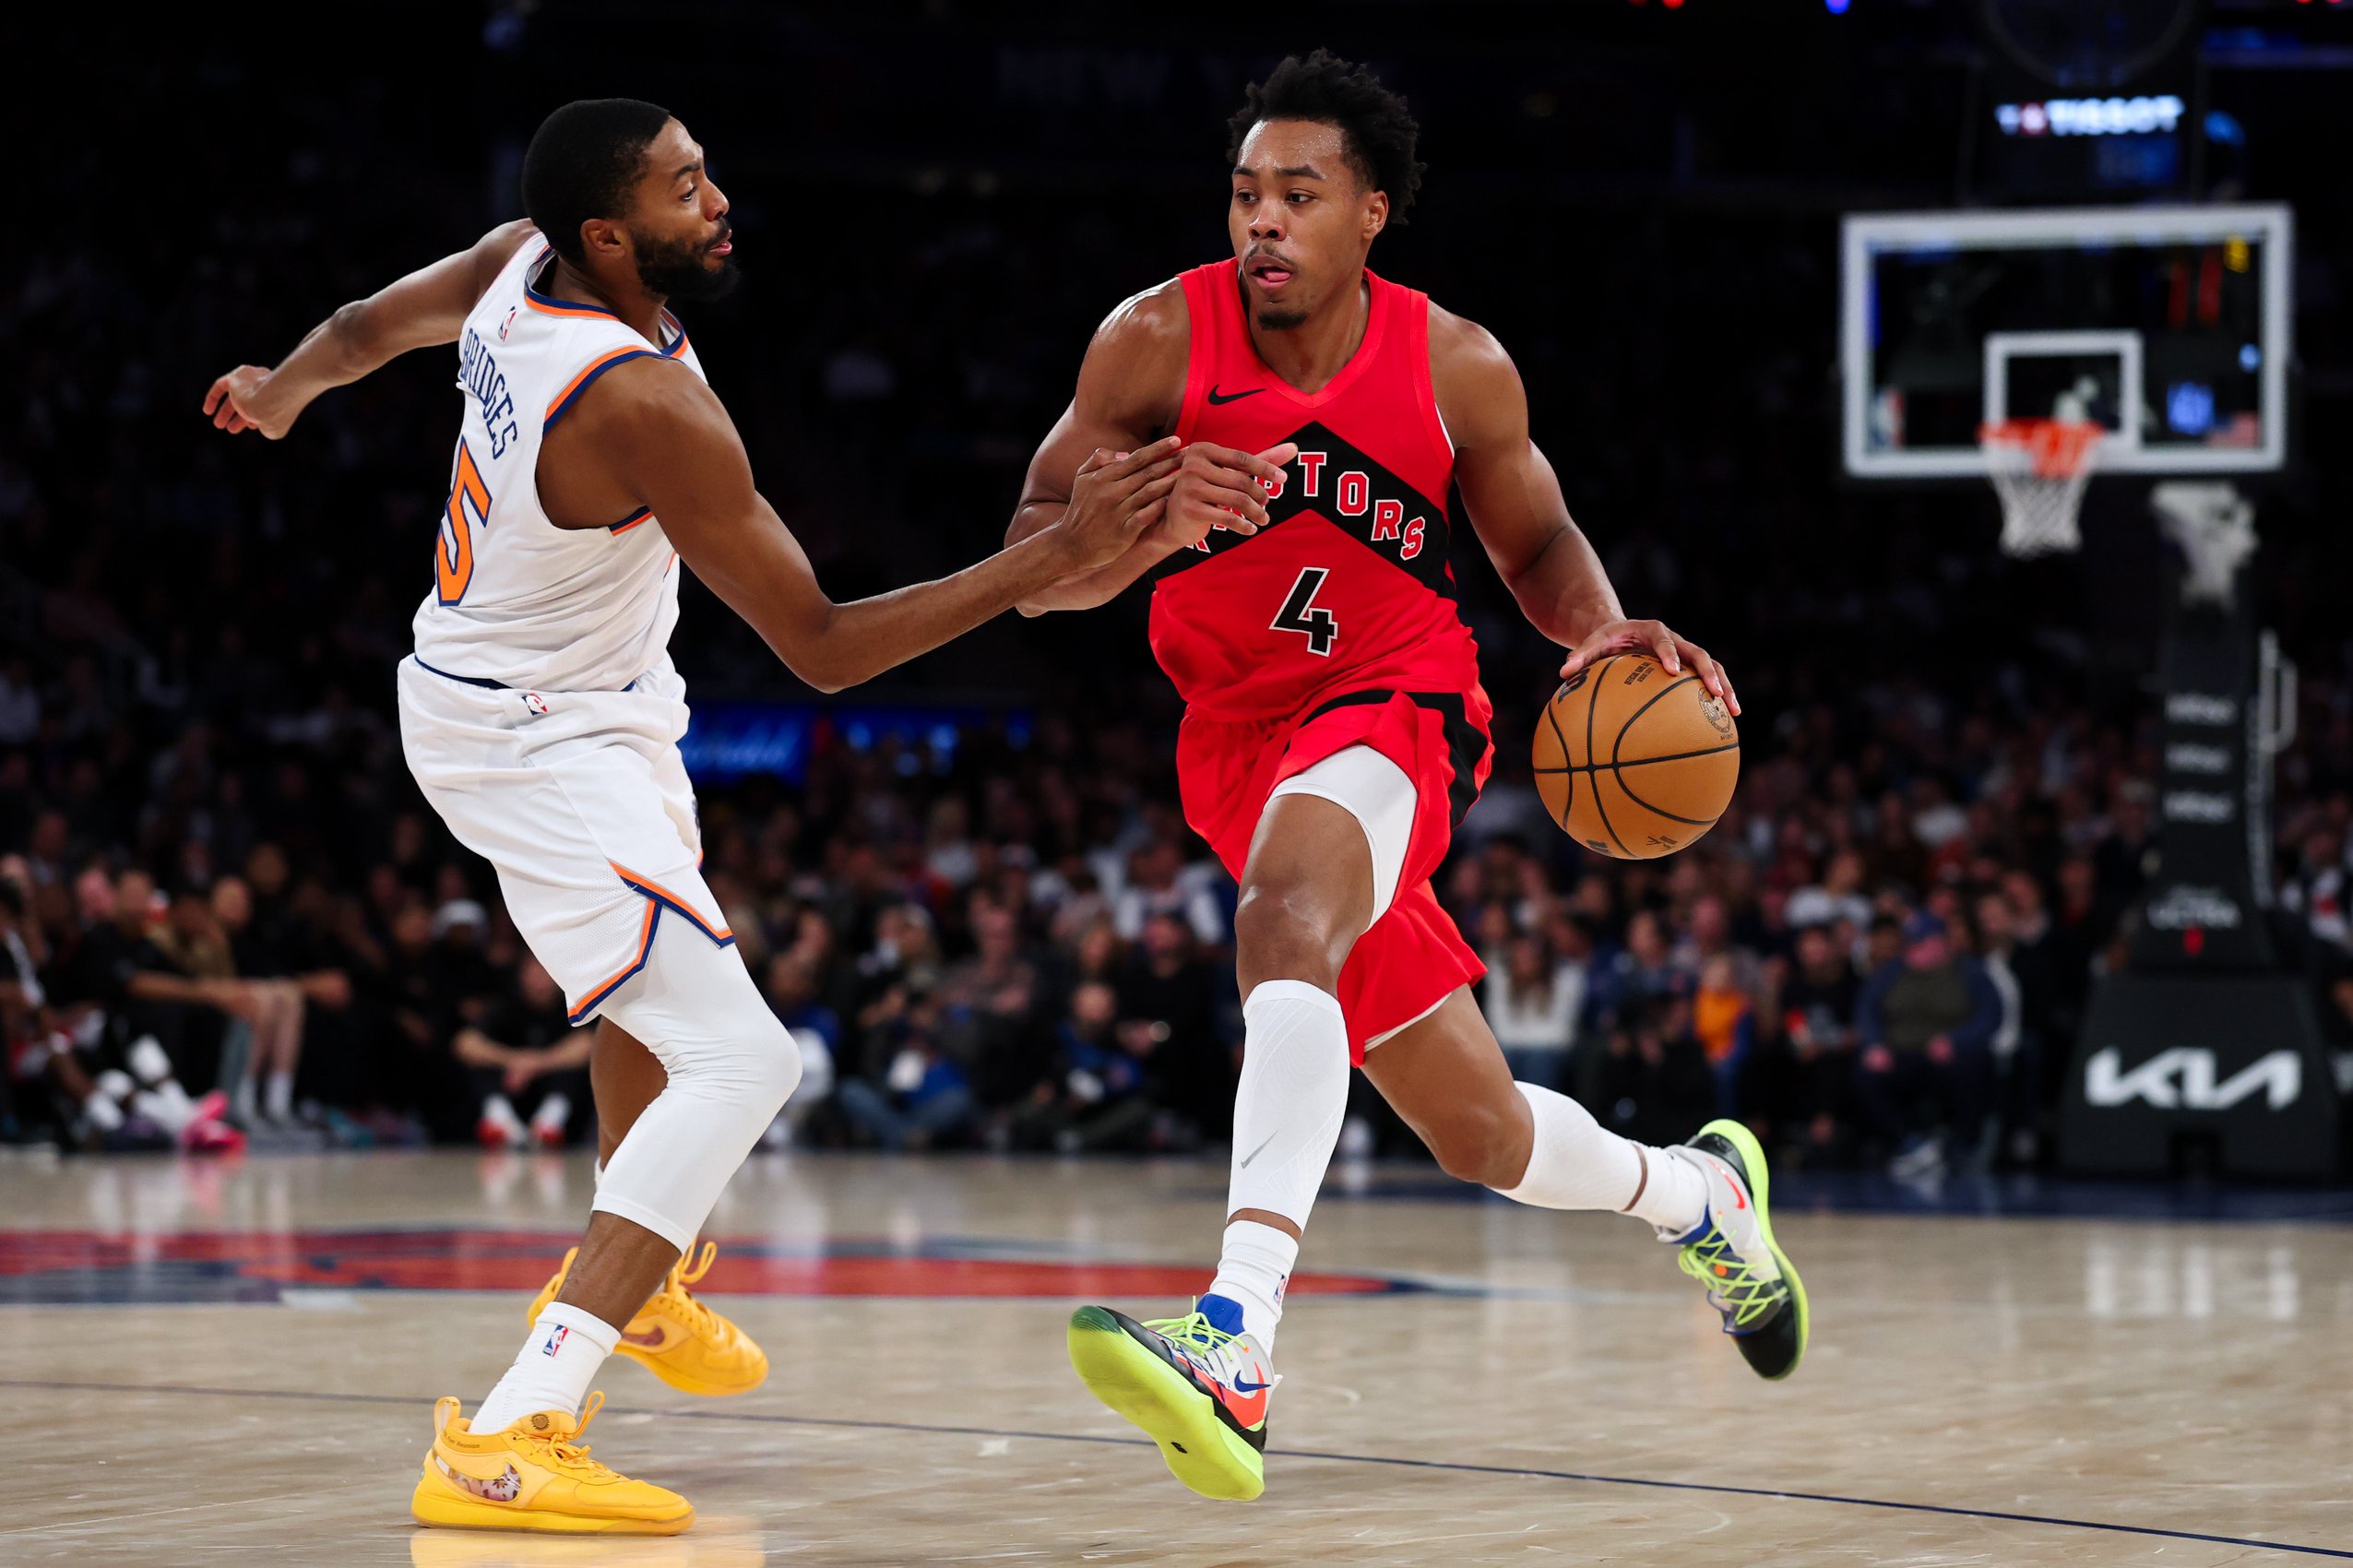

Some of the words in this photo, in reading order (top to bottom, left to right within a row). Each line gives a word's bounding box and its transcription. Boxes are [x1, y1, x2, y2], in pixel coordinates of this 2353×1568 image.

[460, 327, 518, 460] BRIDGES
[435, 434, 493, 607] 5
[1268, 566, 1338, 657] 4
